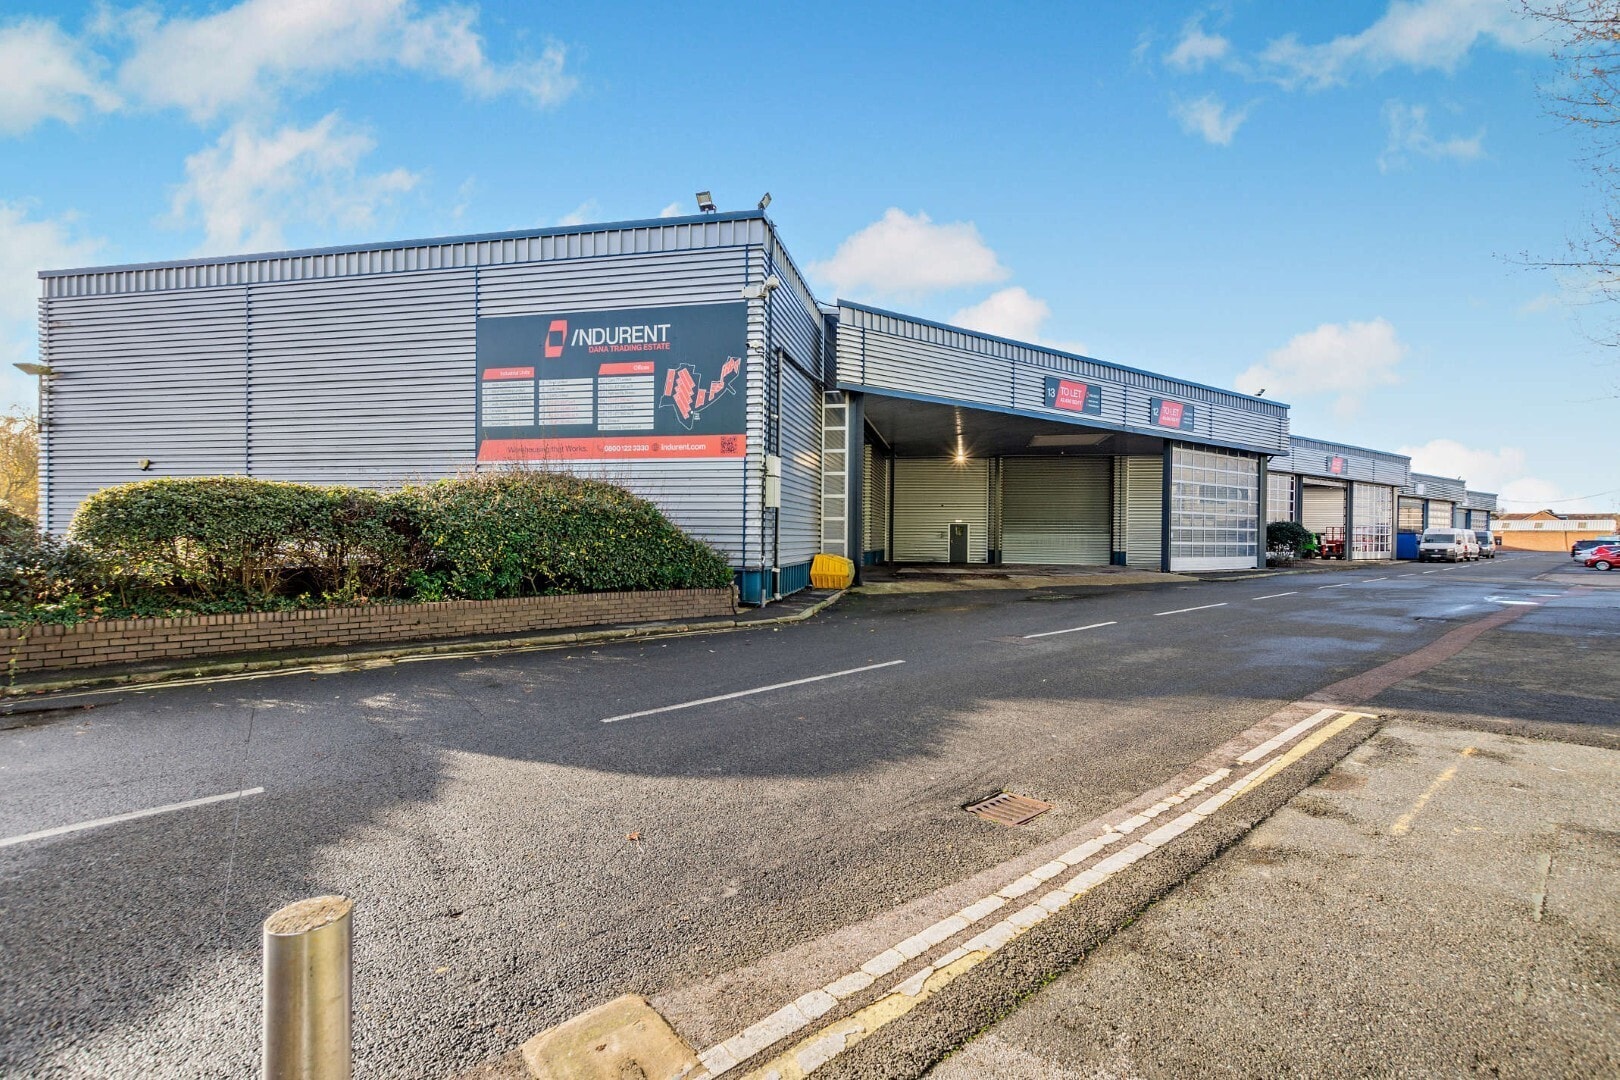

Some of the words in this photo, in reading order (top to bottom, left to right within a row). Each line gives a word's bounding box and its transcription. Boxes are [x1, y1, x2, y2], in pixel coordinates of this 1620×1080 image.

[610, 344, 642, 352] TRADING
[643, 342, 670, 350] ESTATE
[1047, 387, 1056, 398] 13
[1060, 386, 1070, 396] TO
[1070, 388, 1082, 398] LET
[1152, 407, 1159, 416] 12
[1162, 406, 1170, 415] TO
[1170, 408, 1179, 417] LET
